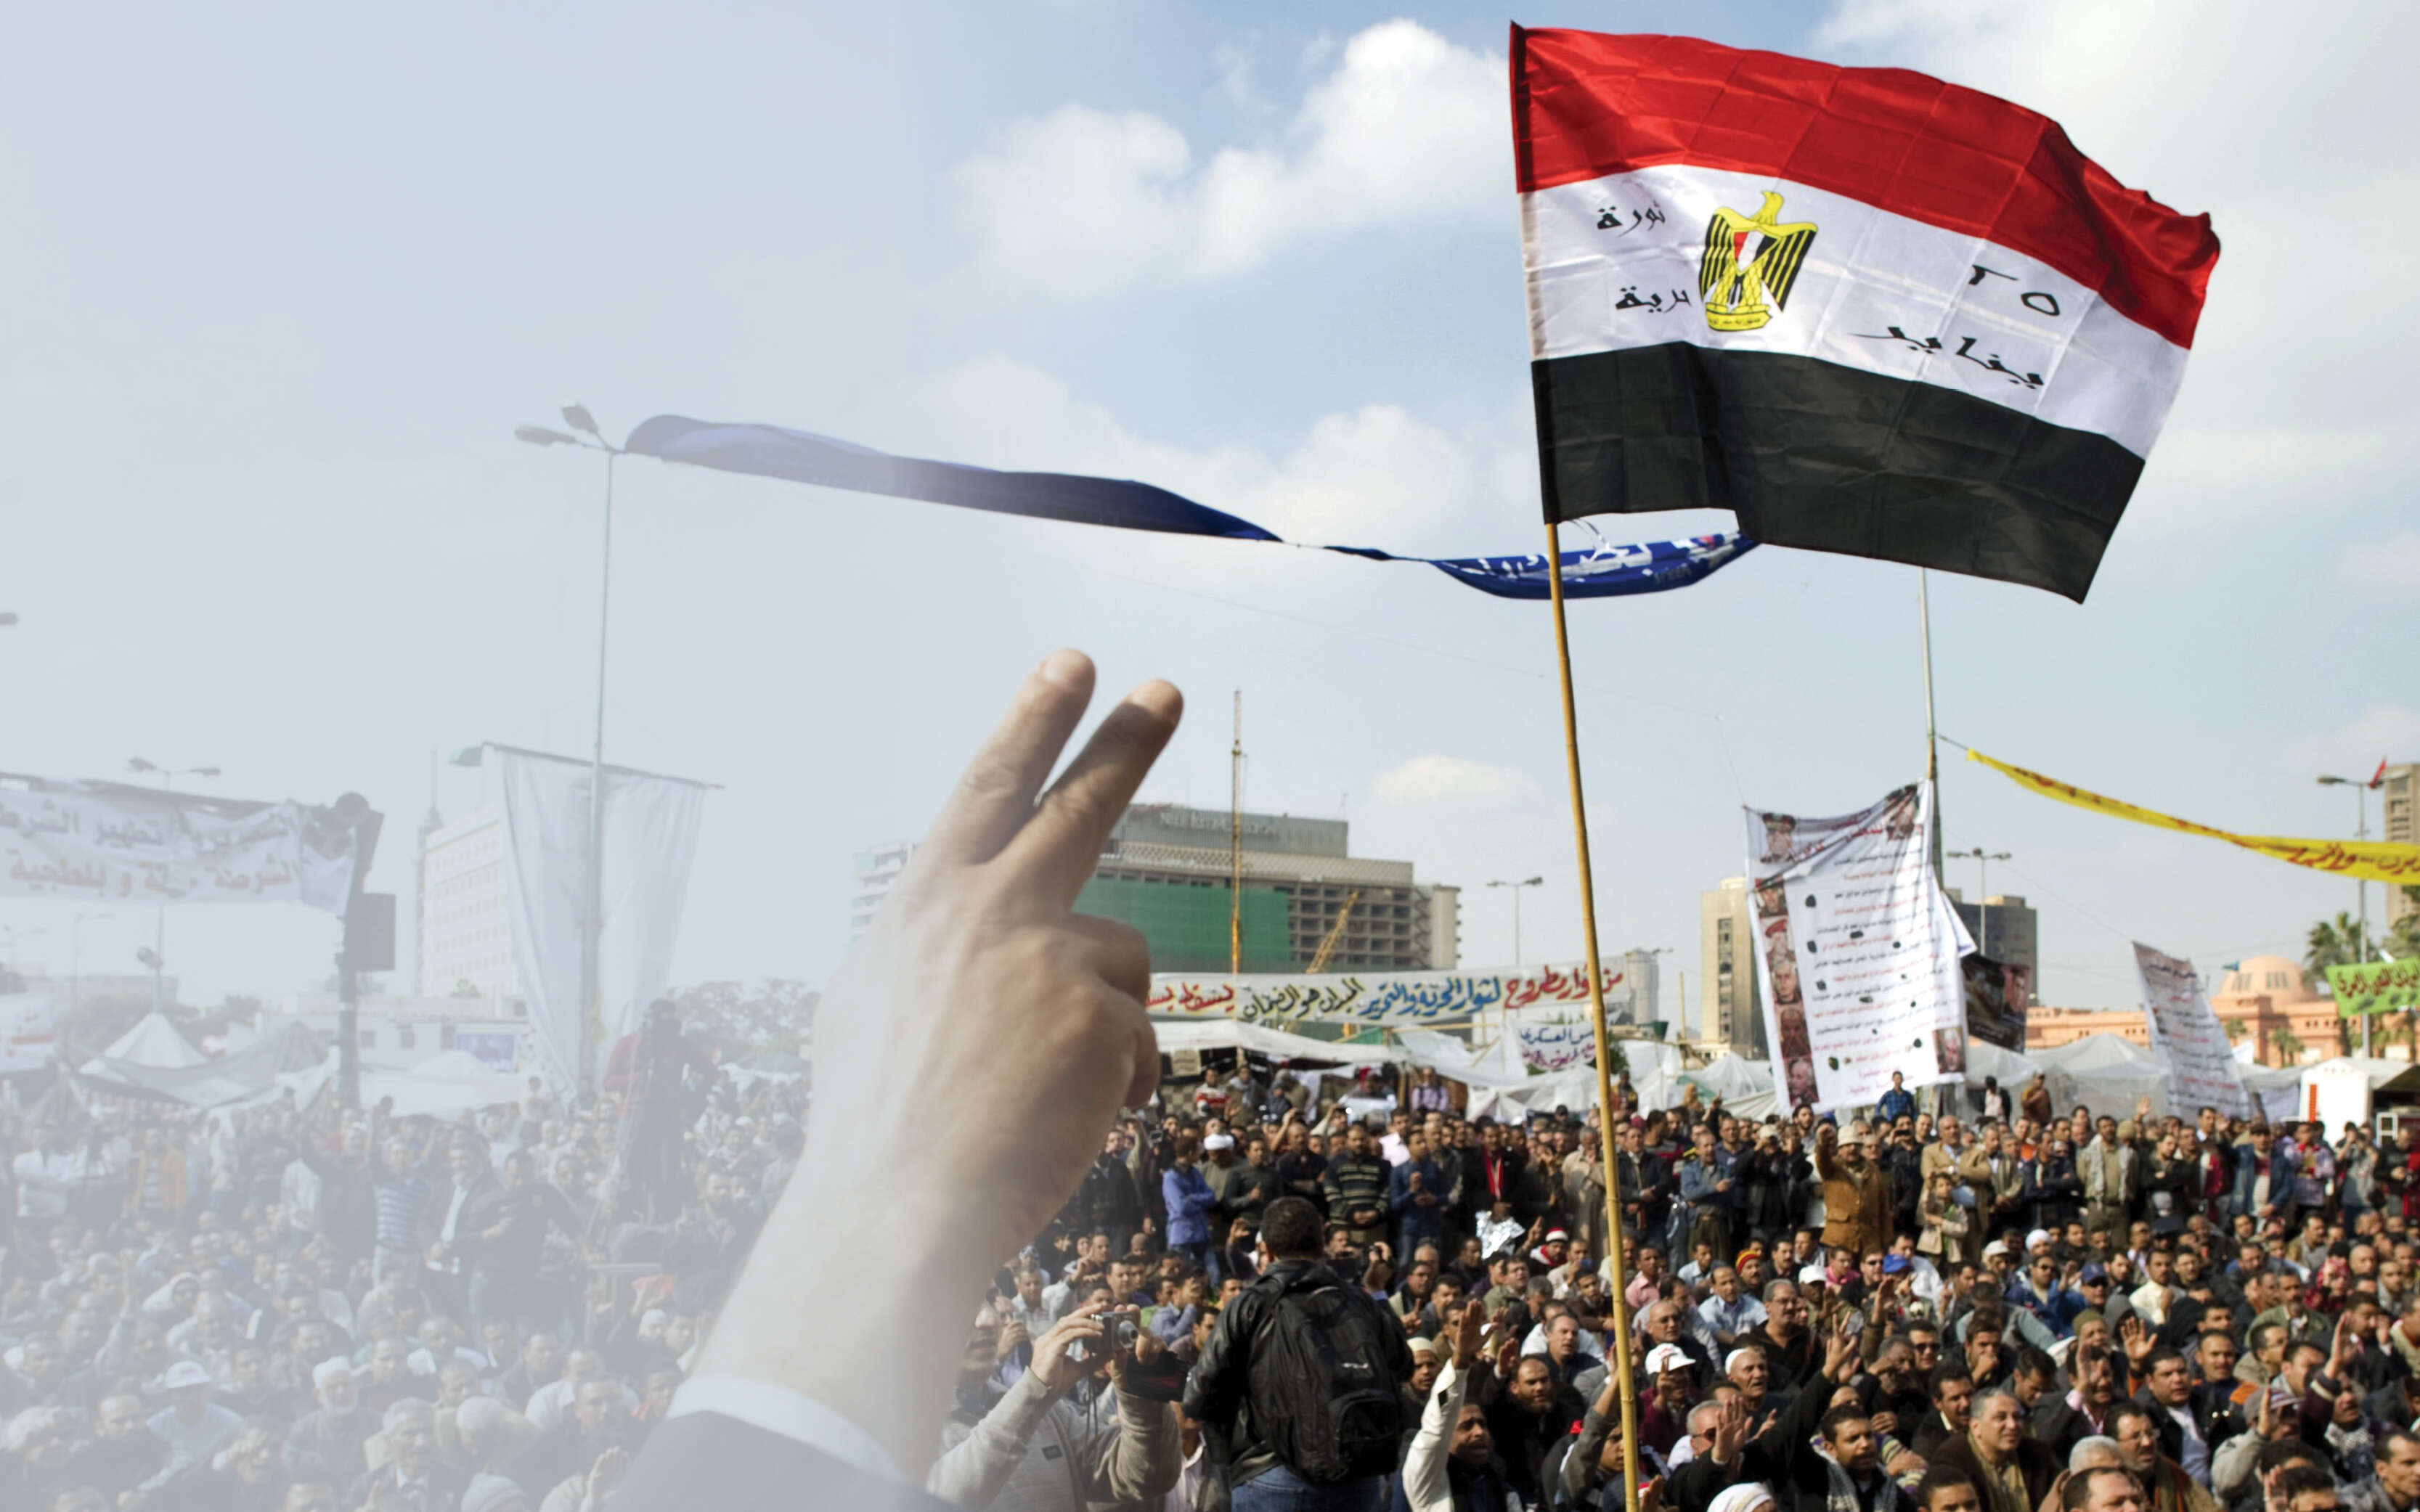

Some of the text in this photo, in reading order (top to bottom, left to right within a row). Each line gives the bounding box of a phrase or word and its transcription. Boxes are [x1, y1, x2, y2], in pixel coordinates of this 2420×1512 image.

[1597, 200, 1666, 237] ثورة
[1968, 264, 2060, 316] ٢٥
[1844, 327, 2044, 389] يناير
[1178, 982, 1234, 1013] يسقط
[1243, 984, 1300, 1018] الضمان
[1296, 987, 1320, 1018] هو
